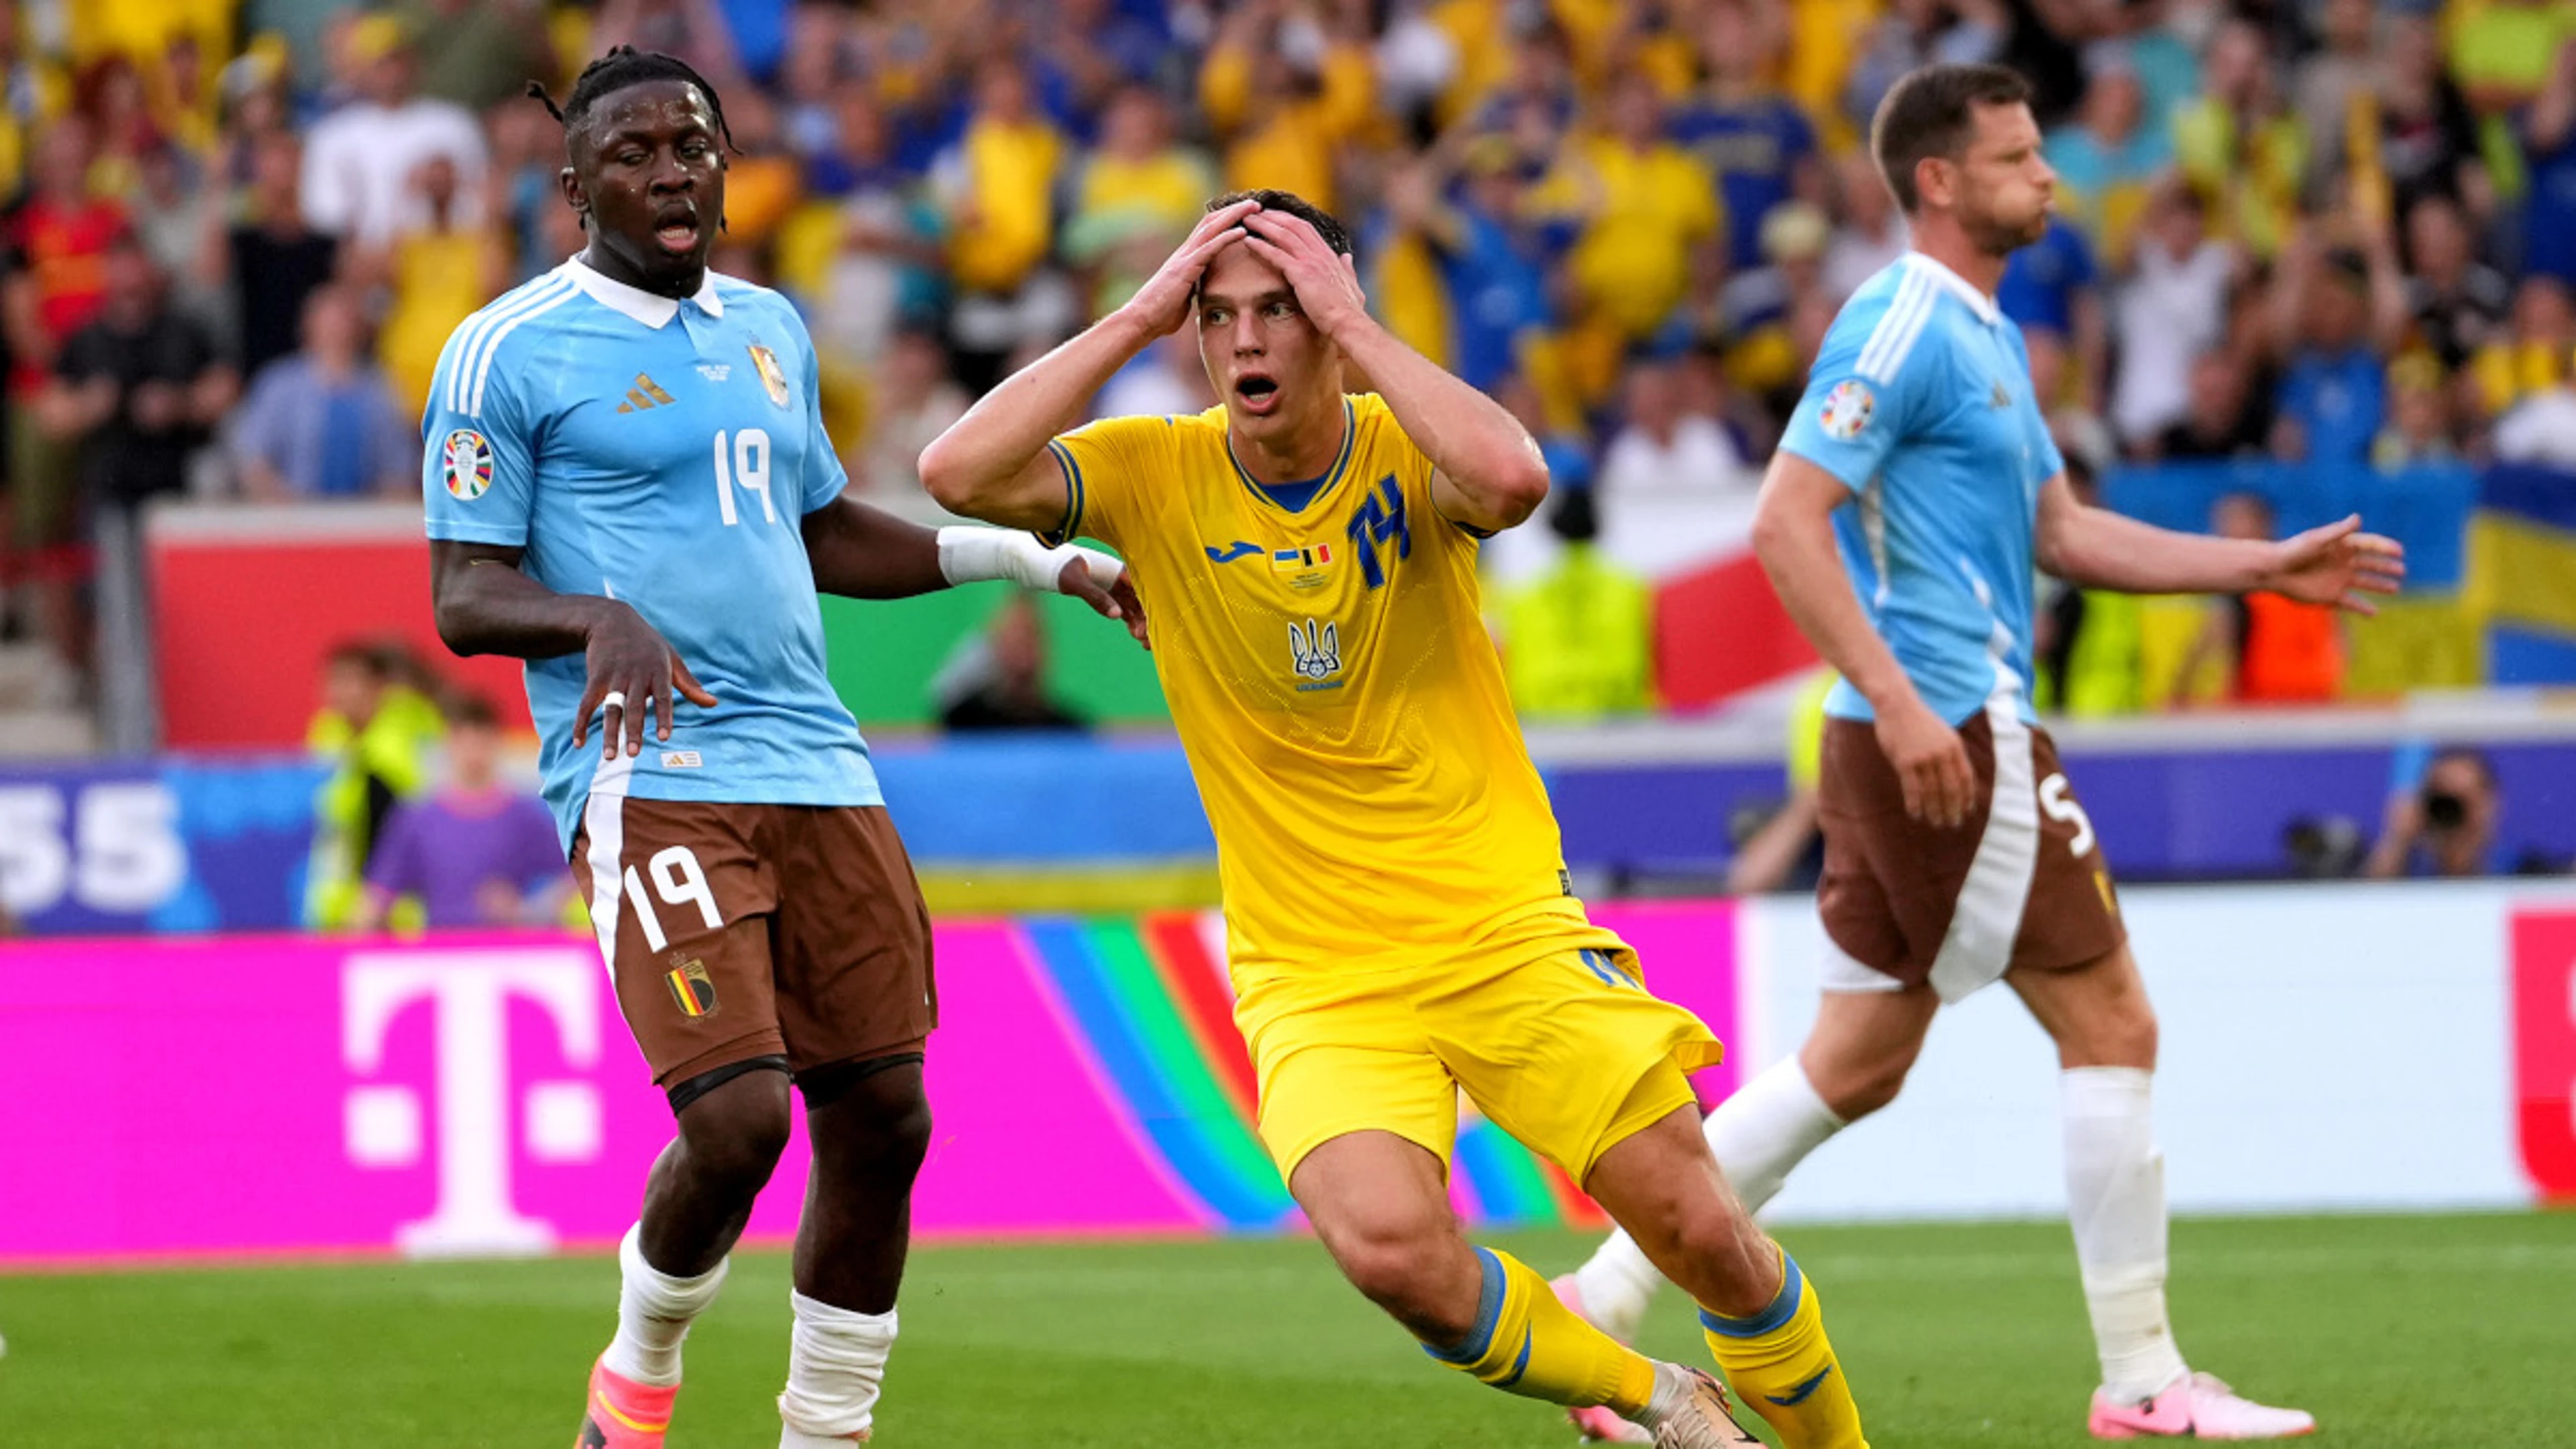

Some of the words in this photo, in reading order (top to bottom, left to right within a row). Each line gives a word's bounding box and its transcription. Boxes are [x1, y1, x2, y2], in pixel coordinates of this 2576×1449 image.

[714, 428, 775, 525] 19
[1346, 471, 1411, 591] 14
[2039, 773, 2095, 858] 5
[624, 845, 724, 953] 19
[343, 948, 602, 1259] T
